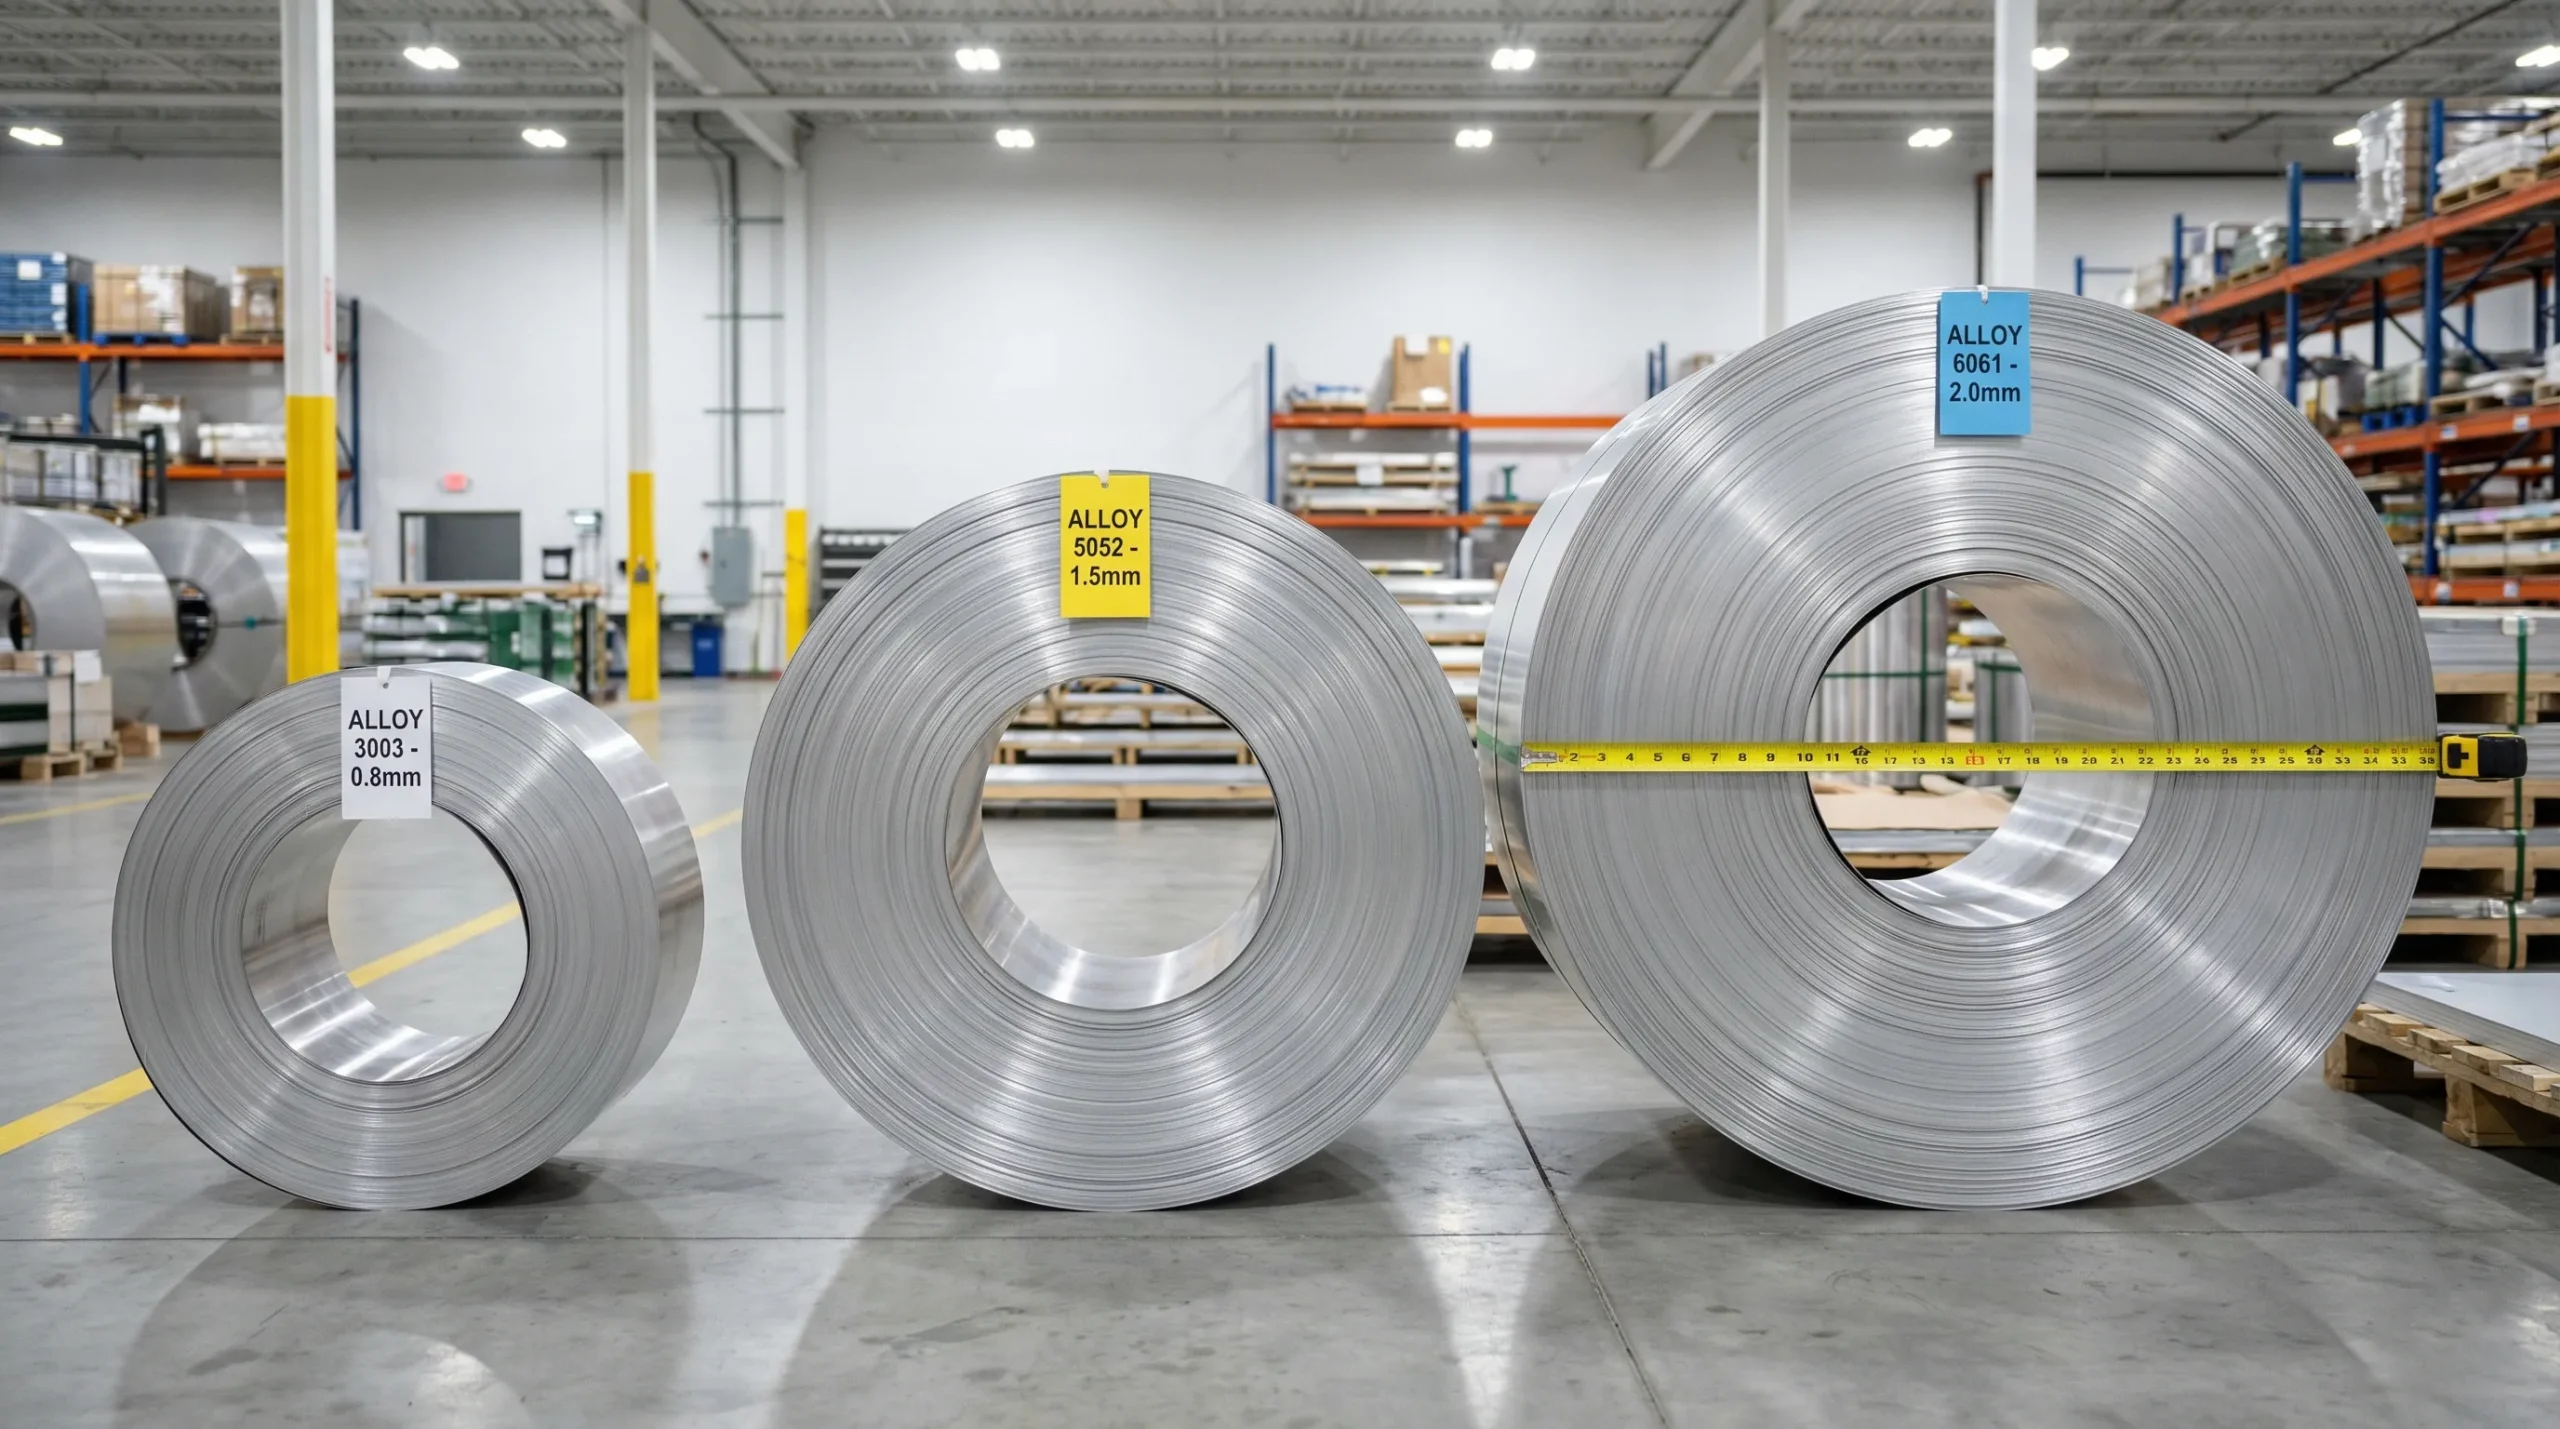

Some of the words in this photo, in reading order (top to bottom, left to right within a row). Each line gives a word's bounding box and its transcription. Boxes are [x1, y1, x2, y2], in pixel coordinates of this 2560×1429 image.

[1947, 325, 2022, 345] ALLOY
[1953, 353, 2001, 373] 6061
[1950, 382, 2020, 402] 2.0mm
[1068, 508, 1144, 528] ALLOY
[1074, 537, 1123, 557] 5052
[1071, 565, 1140, 585] 1.5mm
[348, 709, 423, 729] ALLOY
[355, 738, 403, 758] 3003
[1569, 753, 1578, 761] 2
[1597, 753, 1606, 761] 3
[1626, 753, 1634, 761] 4
[1654, 753, 1662, 761] 5
[1682, 753, 1690, 761] 6
[1710, 753, 1718, 761] 7
[1738, 753, 1746, 761] 8
[1766, 753, 1775, 761] 9
[1797, 753, 1813, 761] 10
[1825, 753, 1839, 761] 11
[2026, 757, 2040, 765] 18
[2138, 757, 2154, 765] 22
[2166, 757, 2181, 765] 23
[351, 766, 420, 786] 0.8mm
